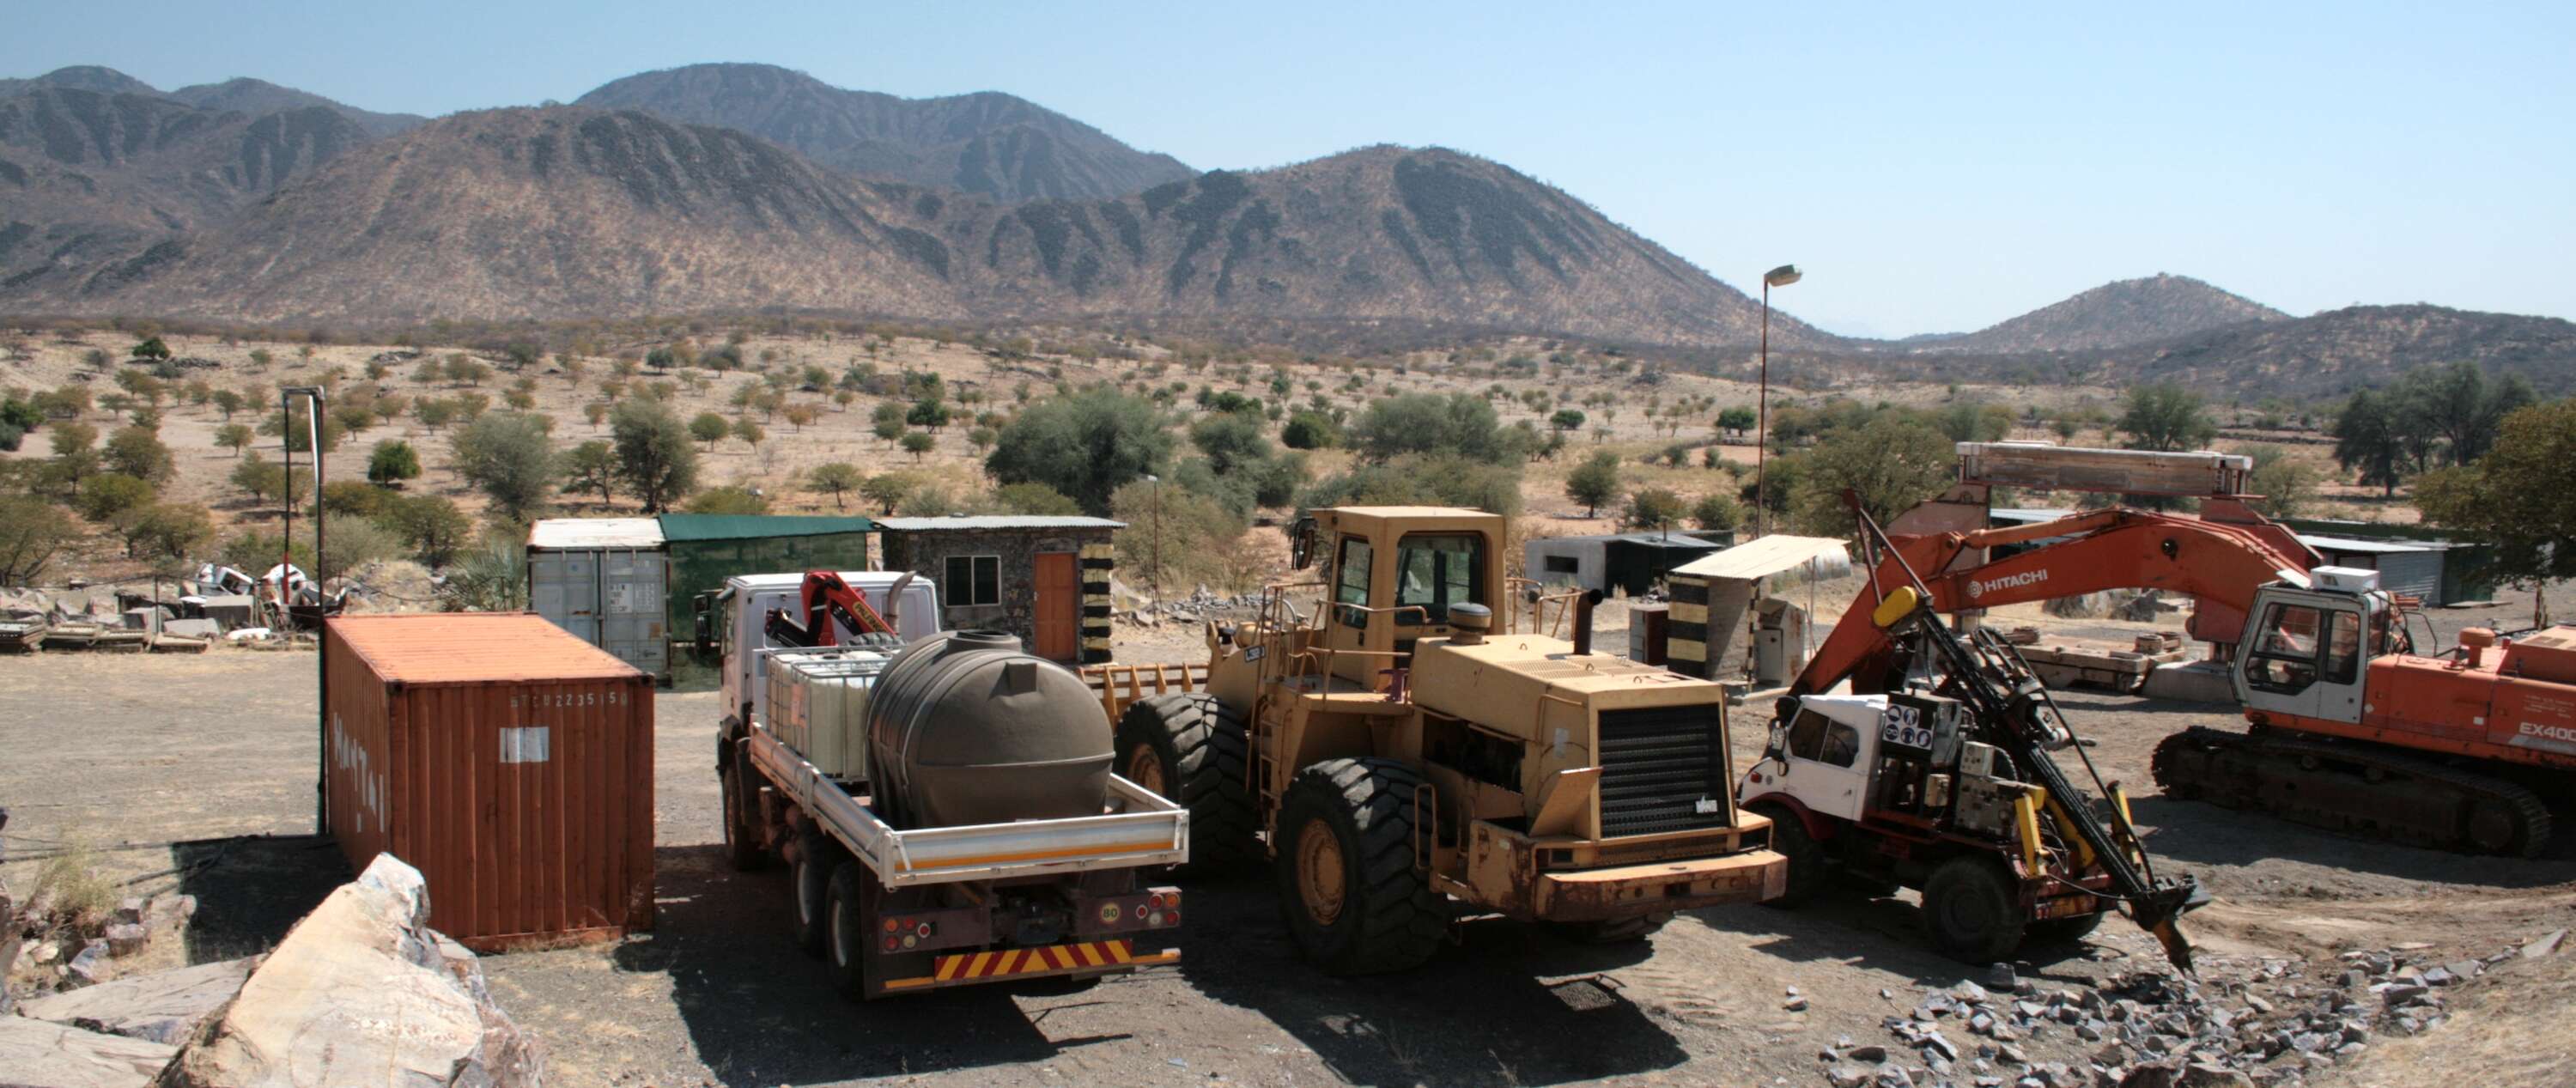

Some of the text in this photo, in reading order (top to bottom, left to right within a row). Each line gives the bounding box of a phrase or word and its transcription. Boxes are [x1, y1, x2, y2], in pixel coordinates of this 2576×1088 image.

[1984, 568, 2048, 592] HITACHI
[2518, 721, 2576, 742] EX400
[1103, 907, 1118, 919] 80
